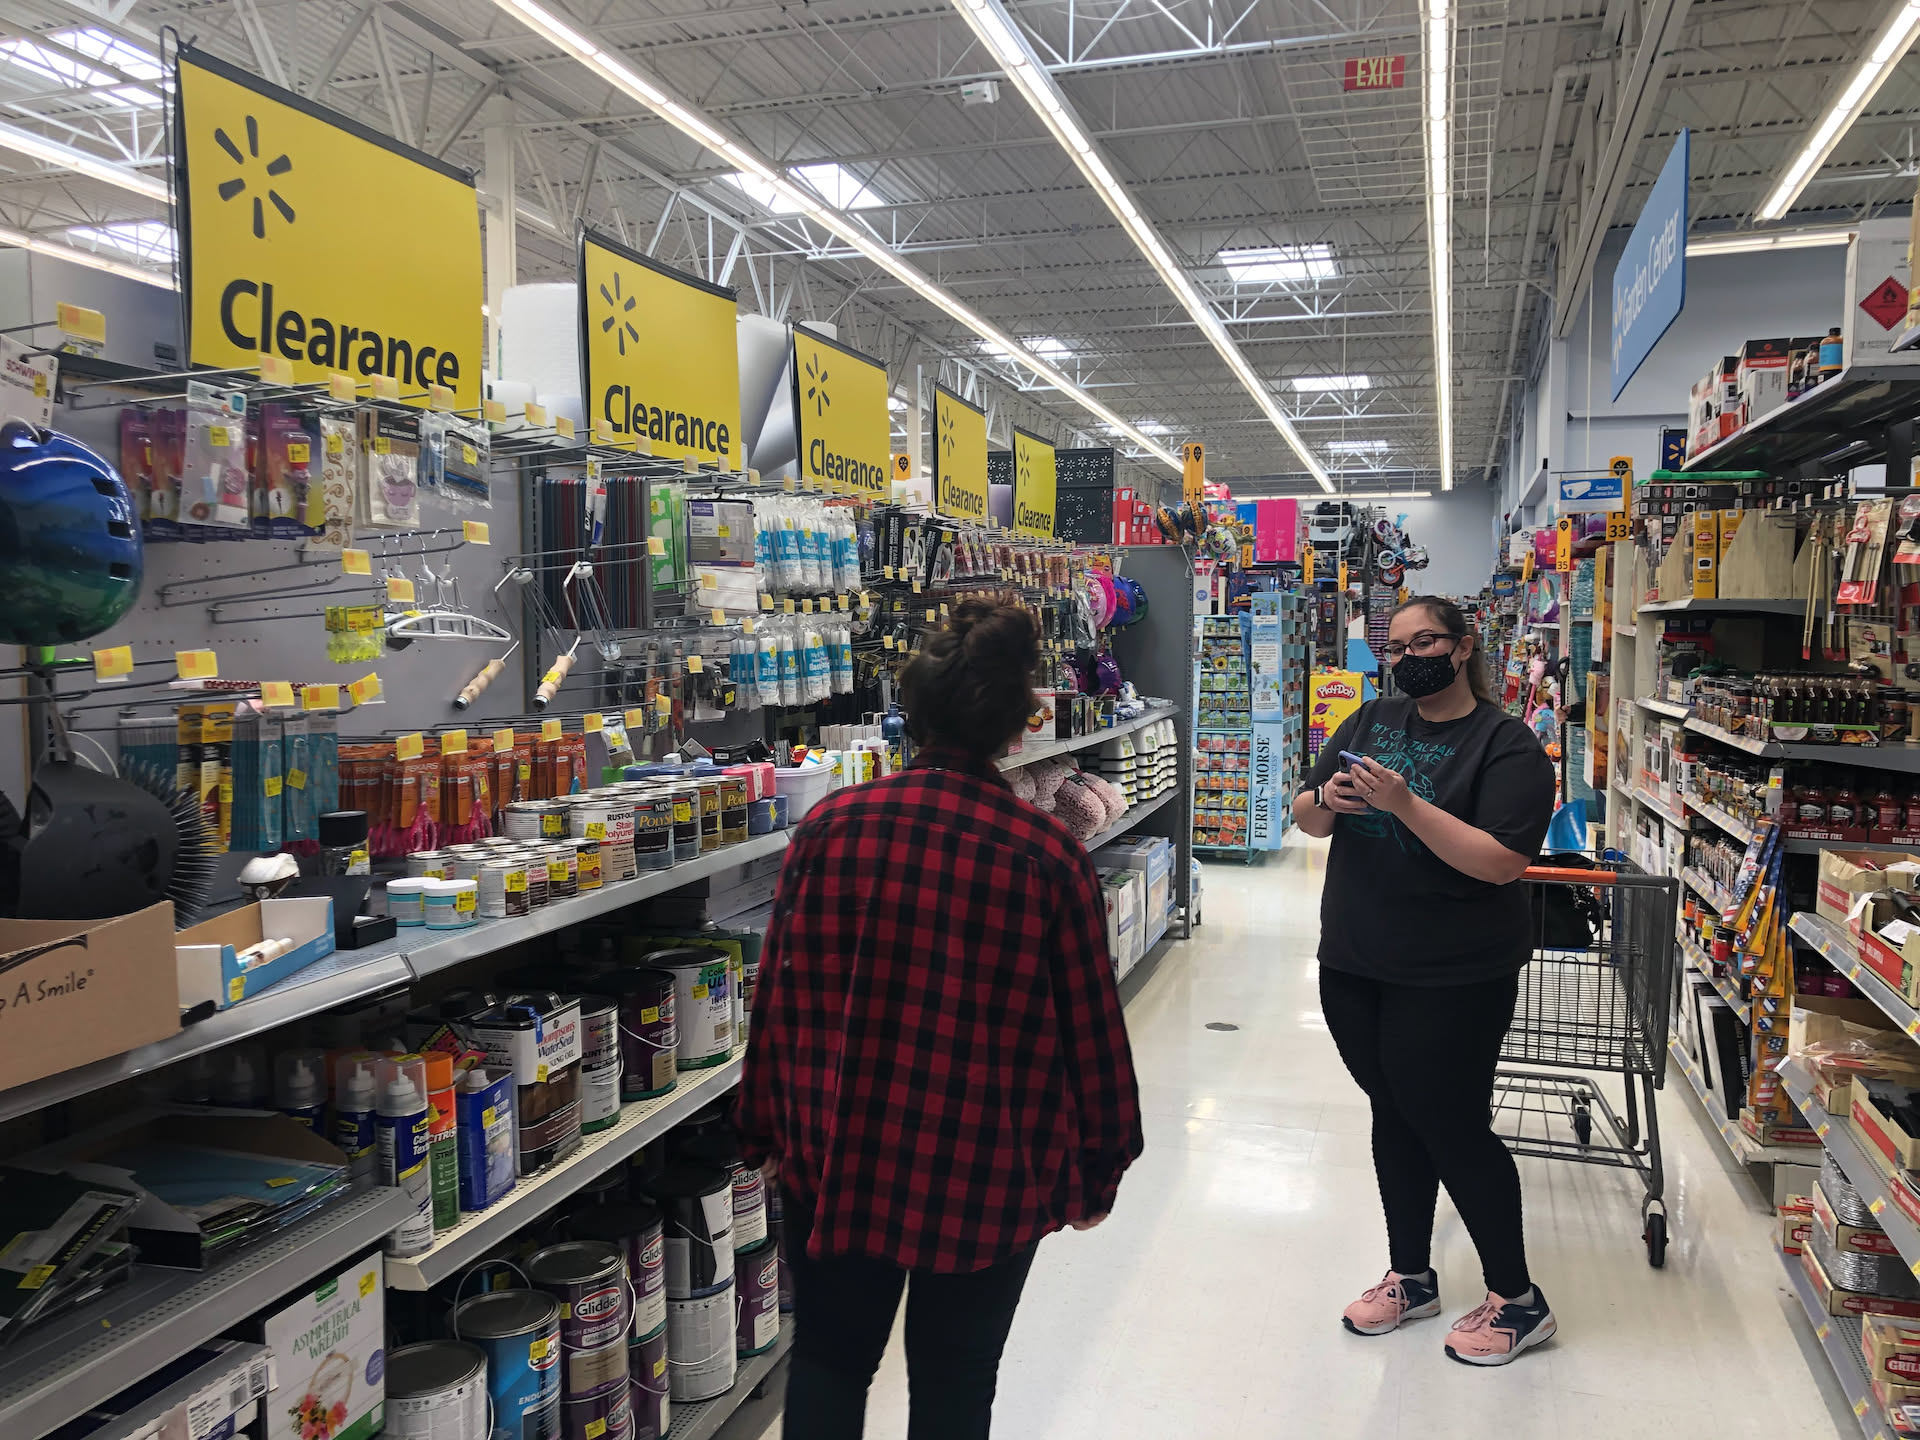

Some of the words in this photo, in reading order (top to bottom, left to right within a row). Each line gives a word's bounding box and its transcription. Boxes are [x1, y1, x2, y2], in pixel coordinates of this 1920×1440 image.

[1356, 57, 1395, 87] EXIT
[1622, 263, 1648, 337] Garden
[1648, 207, 1680, 295] Center
[220, 278, 461, 394] Clearance
[604, 383, 731, 455] Clearance
[810, 438, 885, 491] Clearance
[942, 474, 983, 516] Clearance
[1194, 487, 1202, 500] H
[1017, 501, 1051, 532] Clearance
[1609, 524, 1628, 539] 33
[1244, 547, 1250, 558] J
[1560, 548, 1567, 558] J
[1244, 557, 1250, 567] 2
[1556, 560, 1569, 571] 35
[1305, 576, 1312, 584] 3
[1306, 567, 1312, 576] J
[1371, 722, 1391, 735] MY
[405, 762, 439, 774] FISKARS
[459, 761, 487, 773] FISKARS
[1270, 787, 1278, 805] FOR
[1269, 806, 1278, 822] SEEDS
[1810, 831, 1829, 840] SWEET
[1830, 832, 1843, 840] FIRE
[13, 981, 31, 1009] A
[575, 1291, 621, 1317] Glidden
[292, 1298, 361, 1356] ASYMMETRICAL
[564, 1328, 583, 1337] HIGH
[582, 1318, 619, 1336] ENDURANCE
[308, 1322, 350, 1360] WREATH
